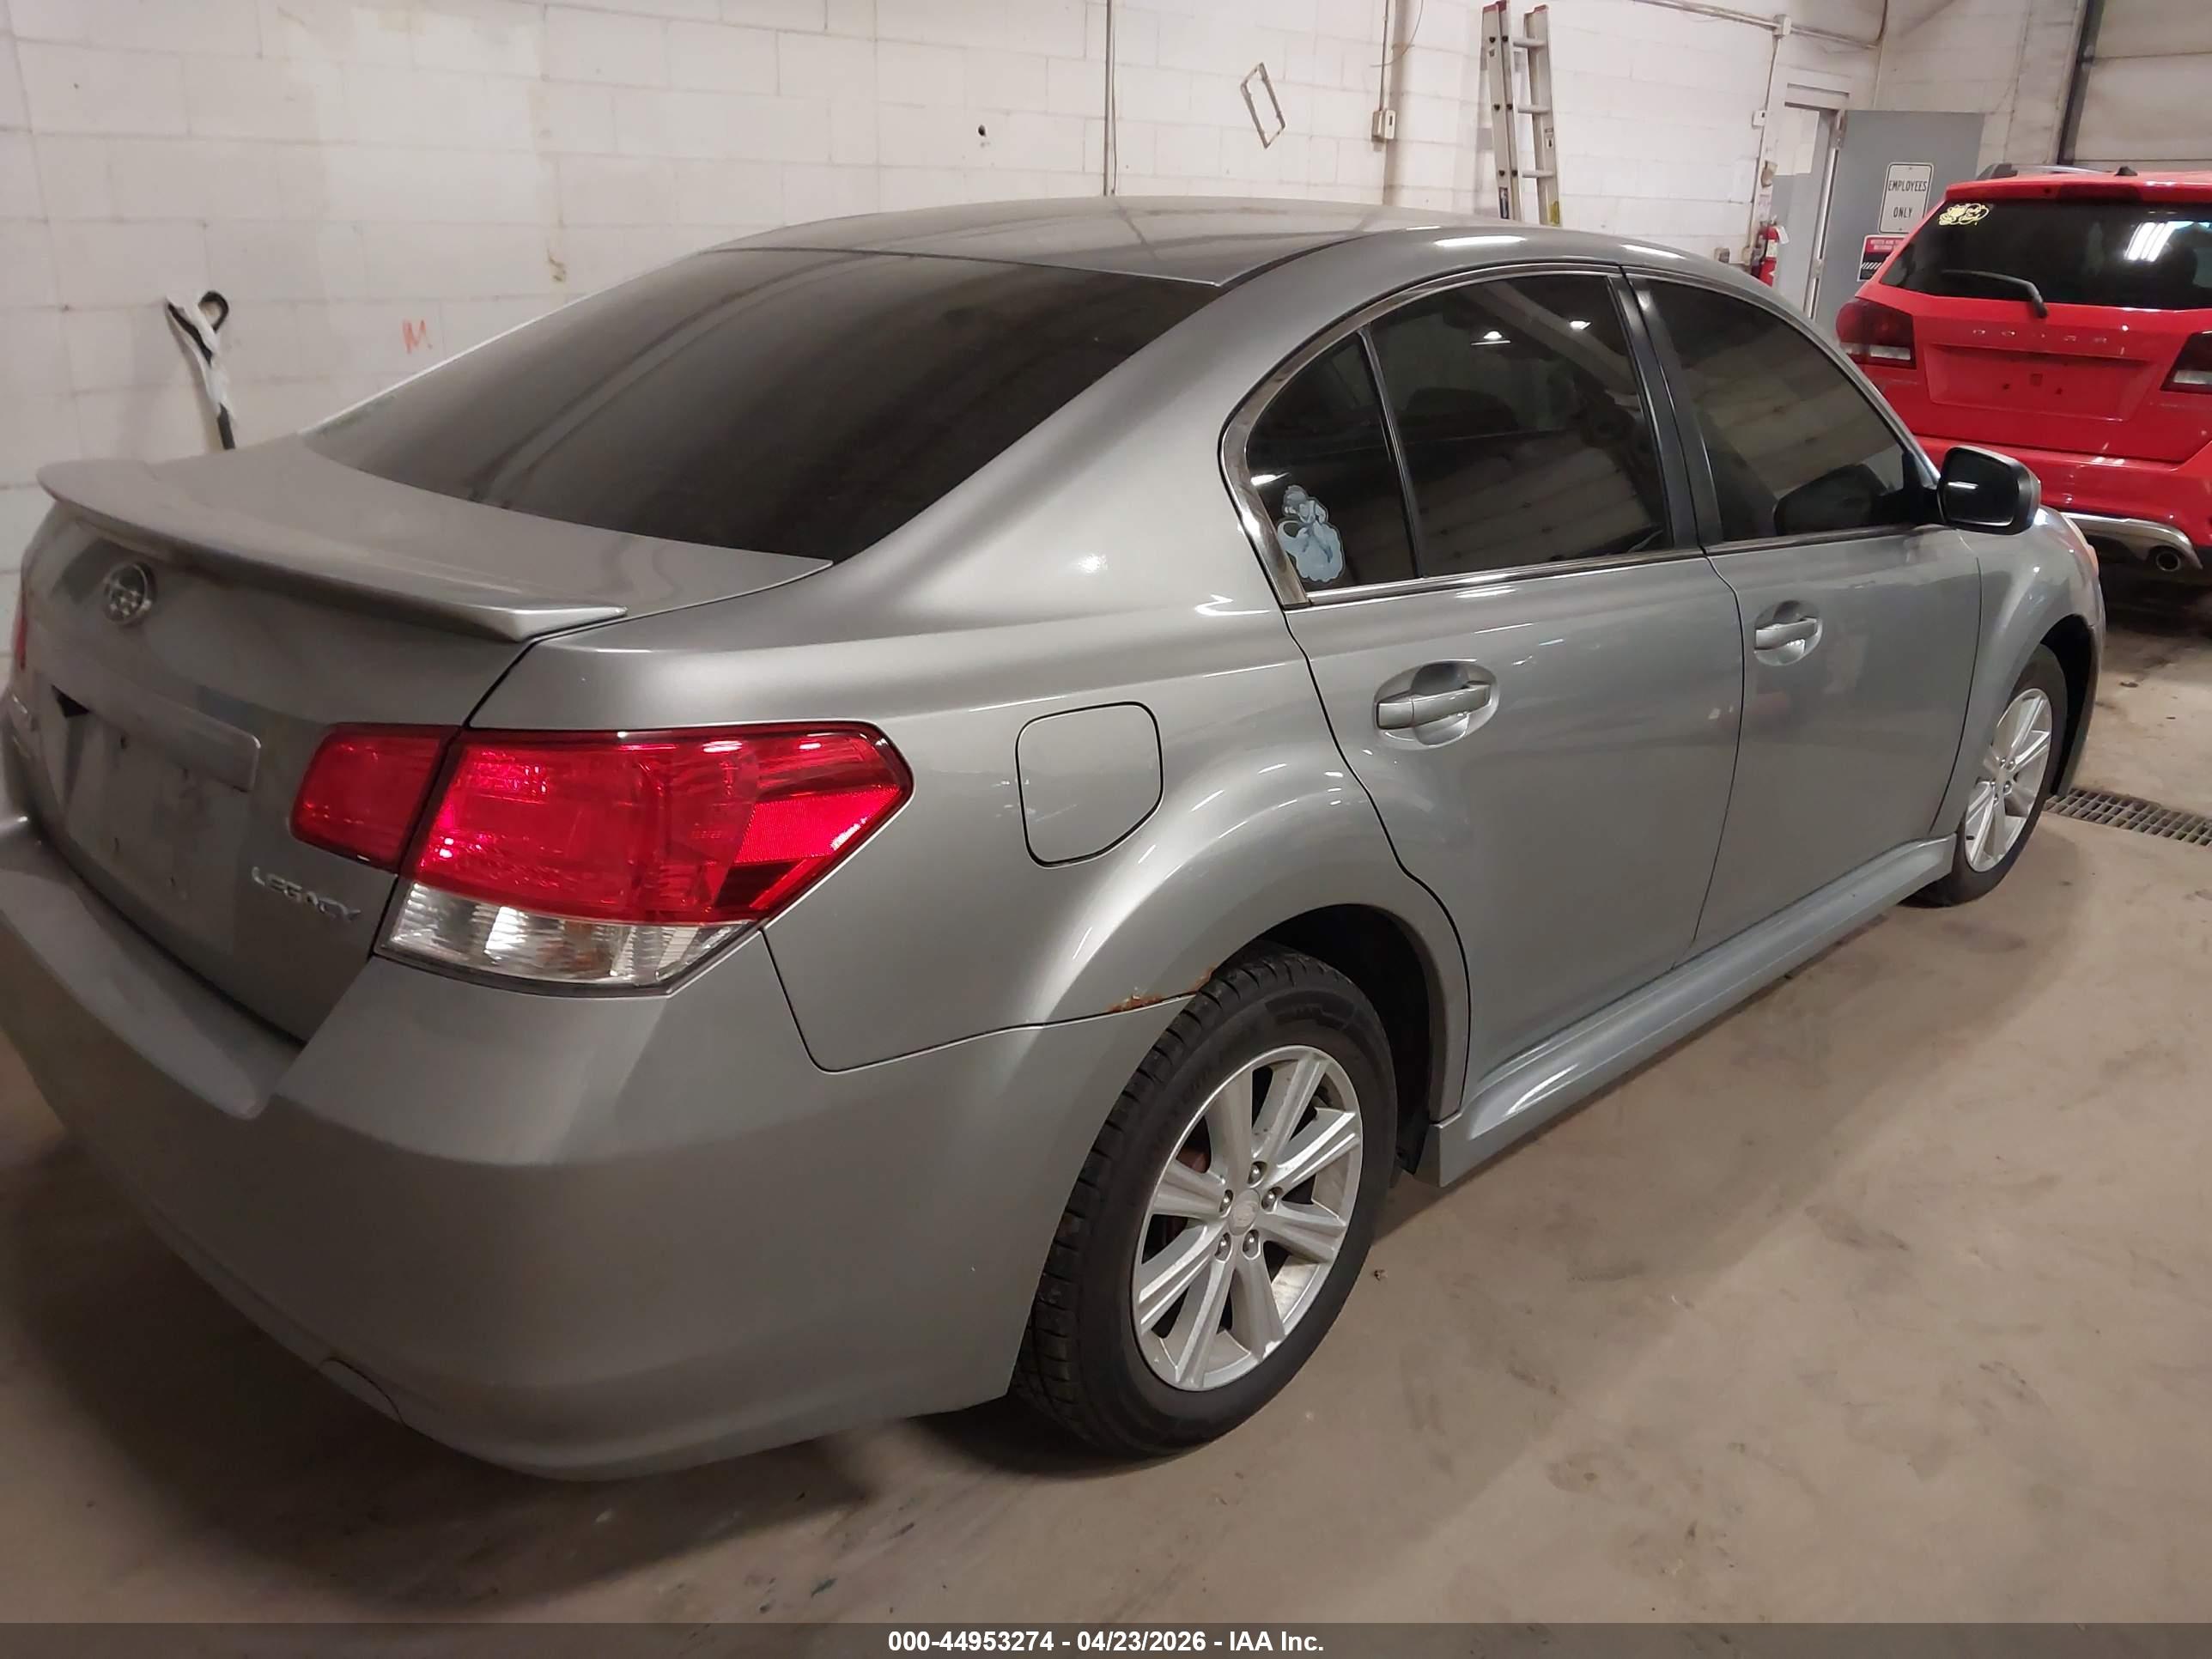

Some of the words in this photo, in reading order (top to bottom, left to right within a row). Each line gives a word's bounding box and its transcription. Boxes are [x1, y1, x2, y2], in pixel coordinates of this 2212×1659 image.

[1888, 180, 1927, 191] EMPLOYEES
[1893, 207, 1912, 218] ONLY
[252, 866, 362, 921] LEGACY
